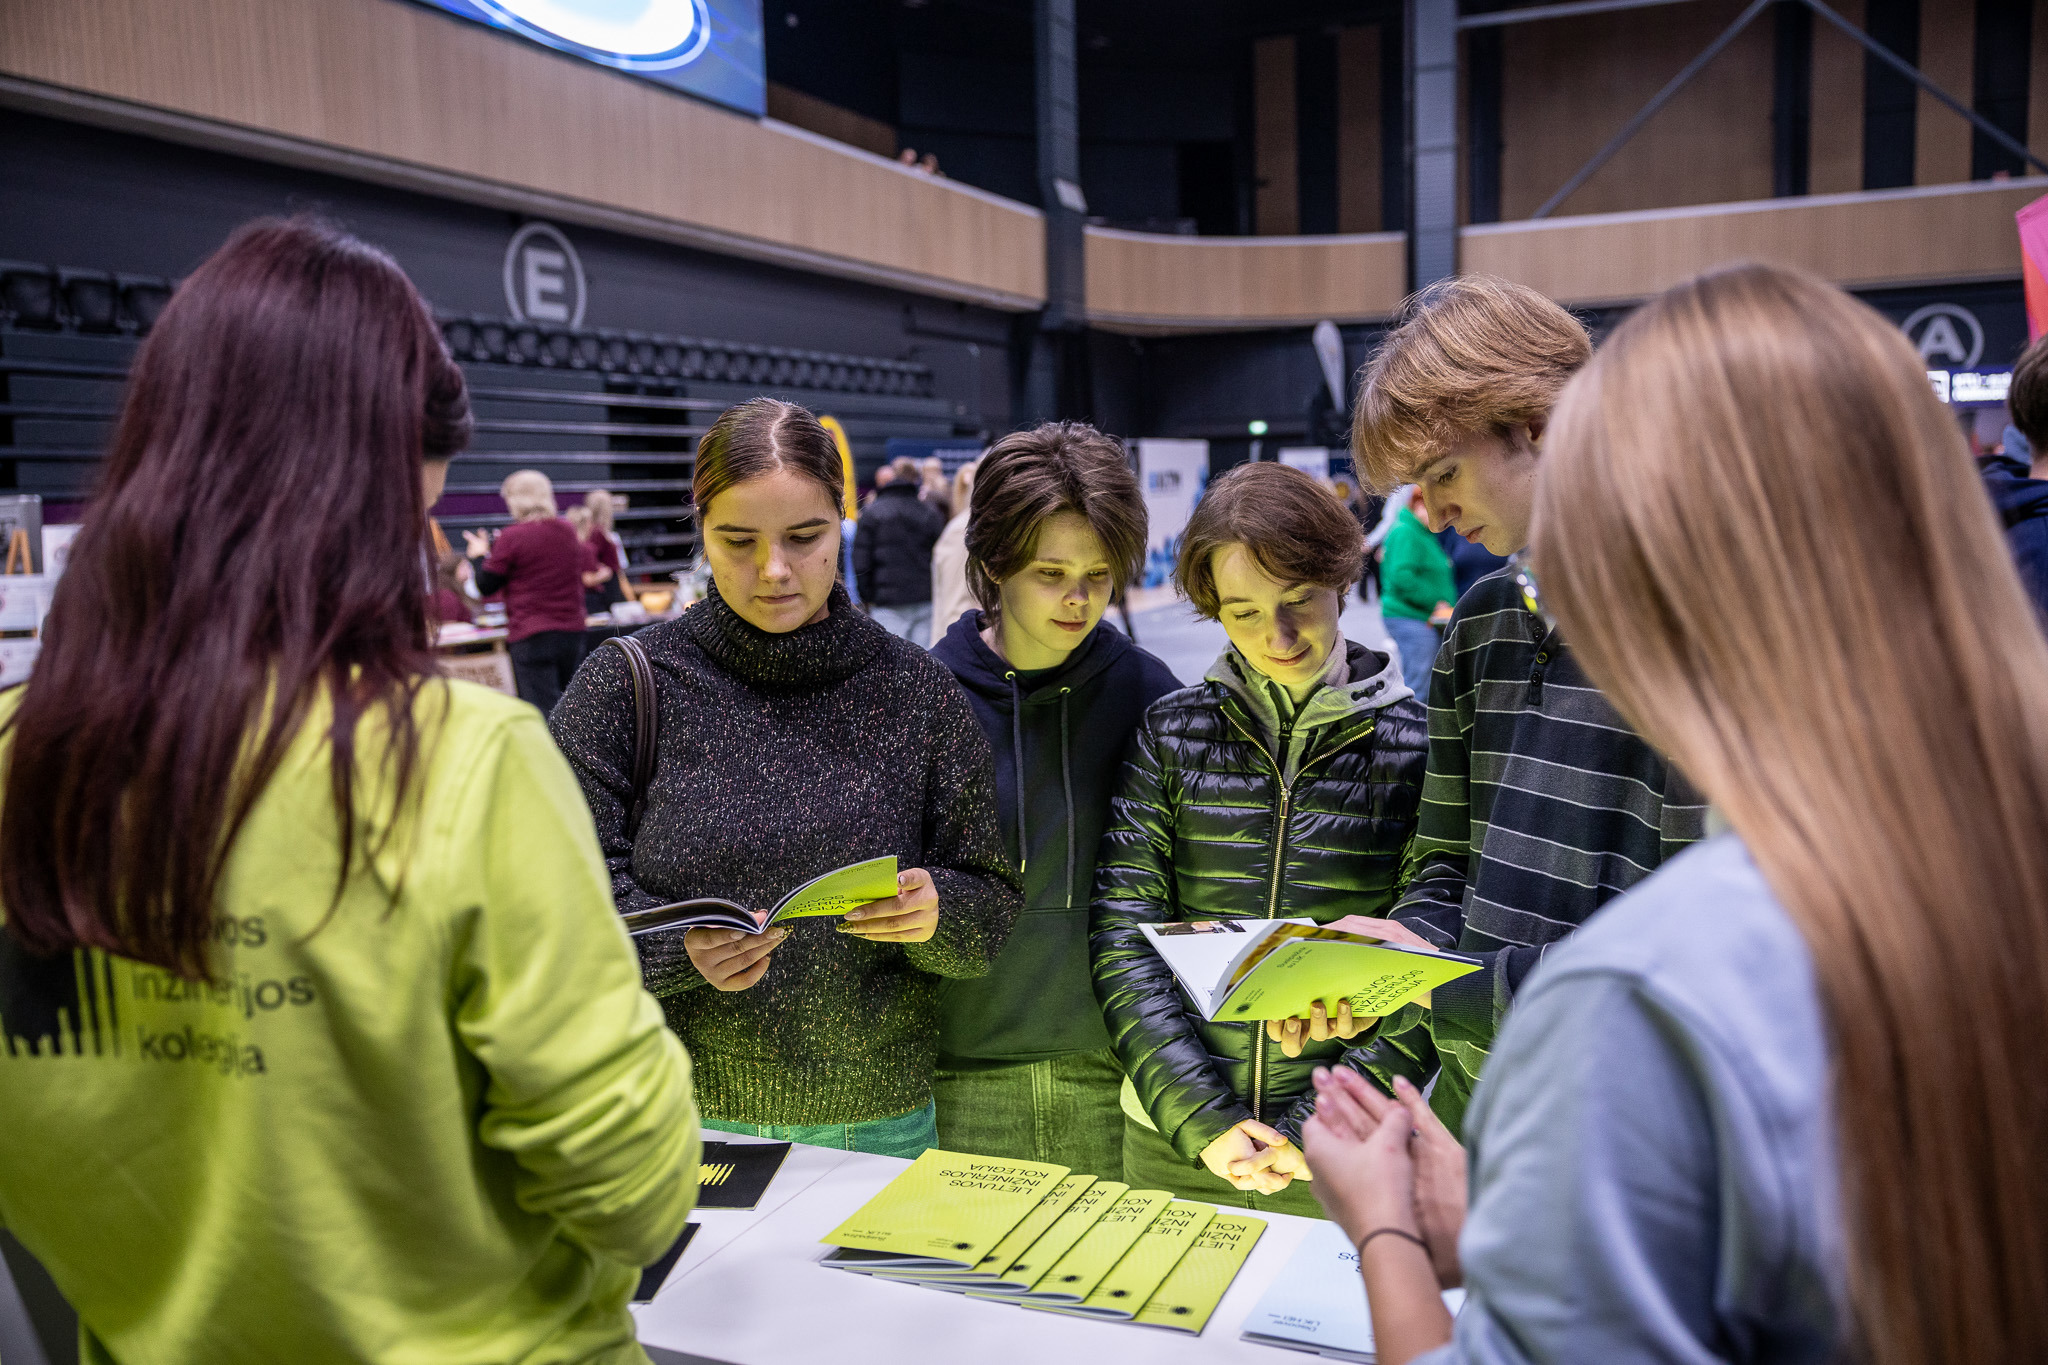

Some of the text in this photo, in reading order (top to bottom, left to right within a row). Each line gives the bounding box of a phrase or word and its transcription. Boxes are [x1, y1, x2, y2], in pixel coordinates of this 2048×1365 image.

[524, 246, 568, 322] E
[1919, 315, 1966, 362] A
[1348, 974, 1395, 1007] ETUVOS
[1367, 979, 1428, 1013] KOLEGIJA
[939, 1169, 1041, 1189] INŽINERIJOS
[949, 1179, 1033, 1195] LIETUVOS
[969, 1163, 1050, 1180] KOLEGIJA
